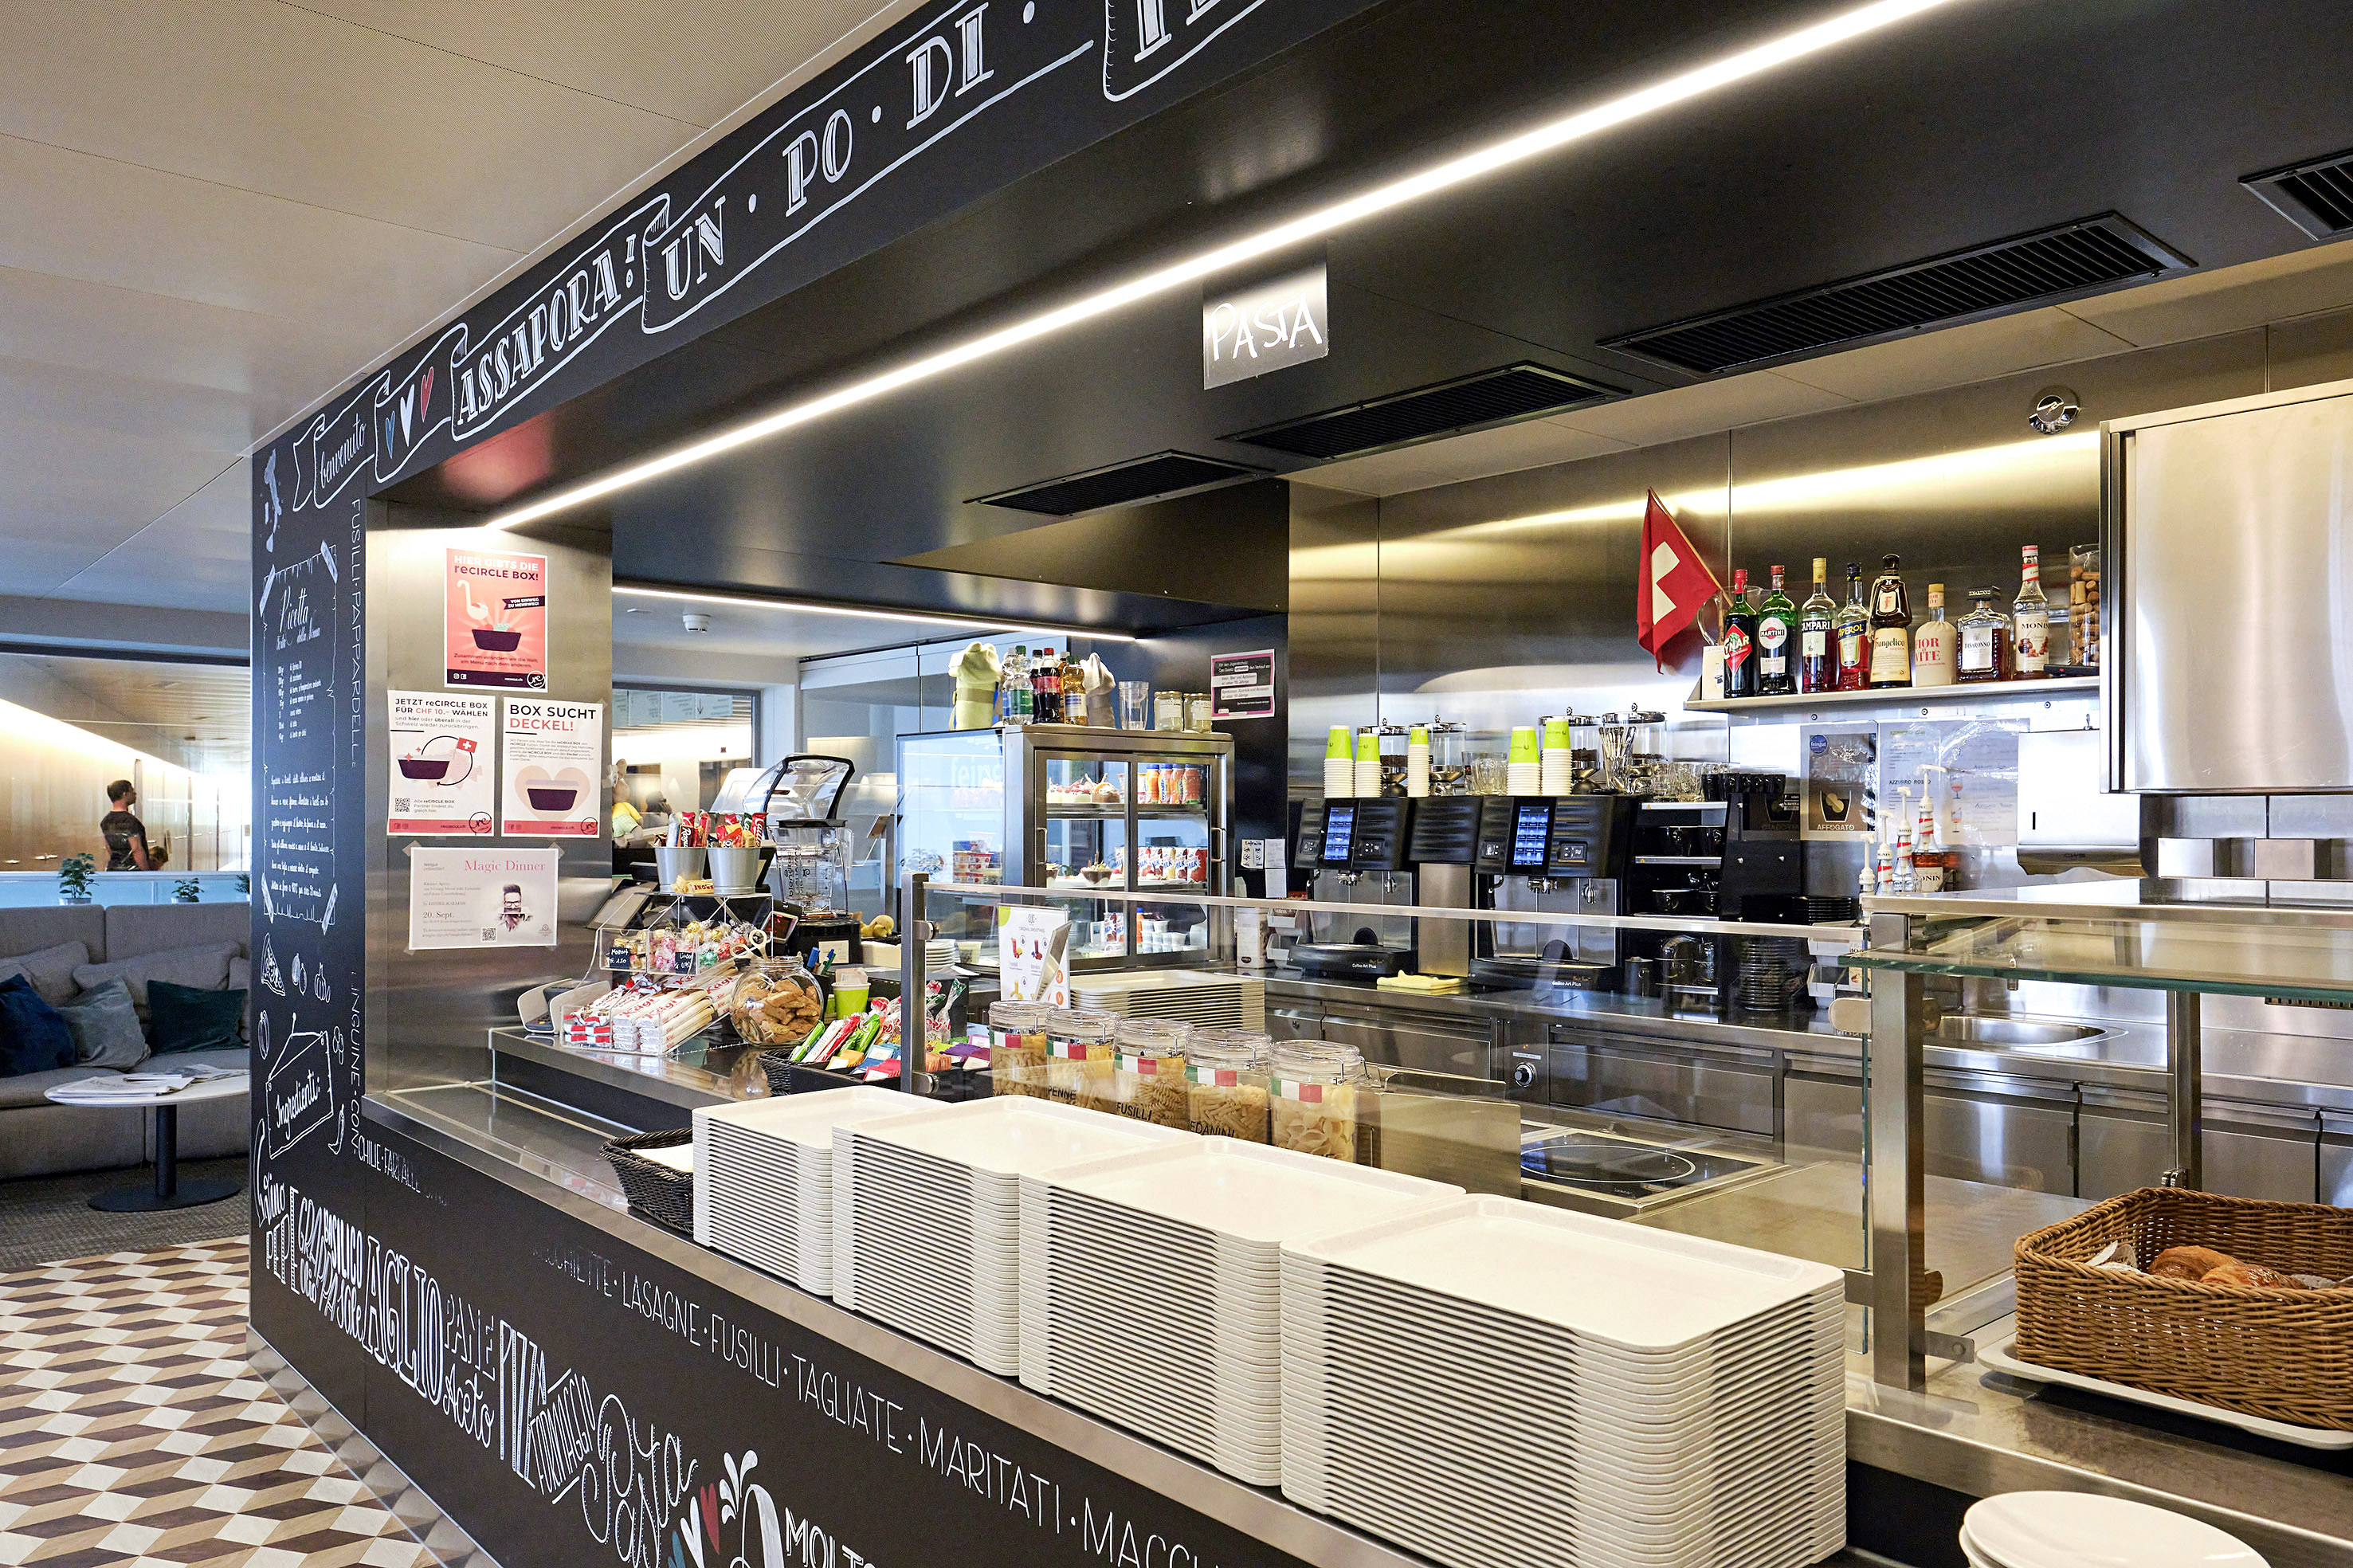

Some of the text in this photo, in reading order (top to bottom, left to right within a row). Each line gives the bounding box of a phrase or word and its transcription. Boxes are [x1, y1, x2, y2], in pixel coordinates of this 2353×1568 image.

[661, 2, 994, 301] UN PO DI
[457, 234, 637, 426] ASSAPORA!
[1208, 292, 1323, 362] PASTA
[351, 499, 361, 582] FUSILLI
[454, 555, 539, 572] HIER GIBTS DIE
[454, 565, 539, 582] reCIRCLE BOX!
[1837, 624, 1864, 638] APEROL
[452, 708, 488, 717] WÄHLEN
[510, 704, 596, 719] BOX SUCHT
[510, 718, 574, 731] DECKEL!
[465, 860, 546, 873] Magic Dinner
[351, 971, 360, 1087] INGUINE
[1049, 1086, 1076, 1100] PENNE
[1117, 1102, 1153, 1121] FUSILLI
[266, 1186, 300, 1295] PEPE
[324, 1207, 363, 1289] BASILICO
[363, 1235, 444, 1405] AGLIO
[622, 1270, 700, 1347] LASAGNE
[712, 1314, 780, 1389] FUSILLI
[791, 1354, 904, 1454] TAGLIATE
[920, 1417, 1061, 1534] MARITATI
[786, 1507, 876, 1567] MOLT
